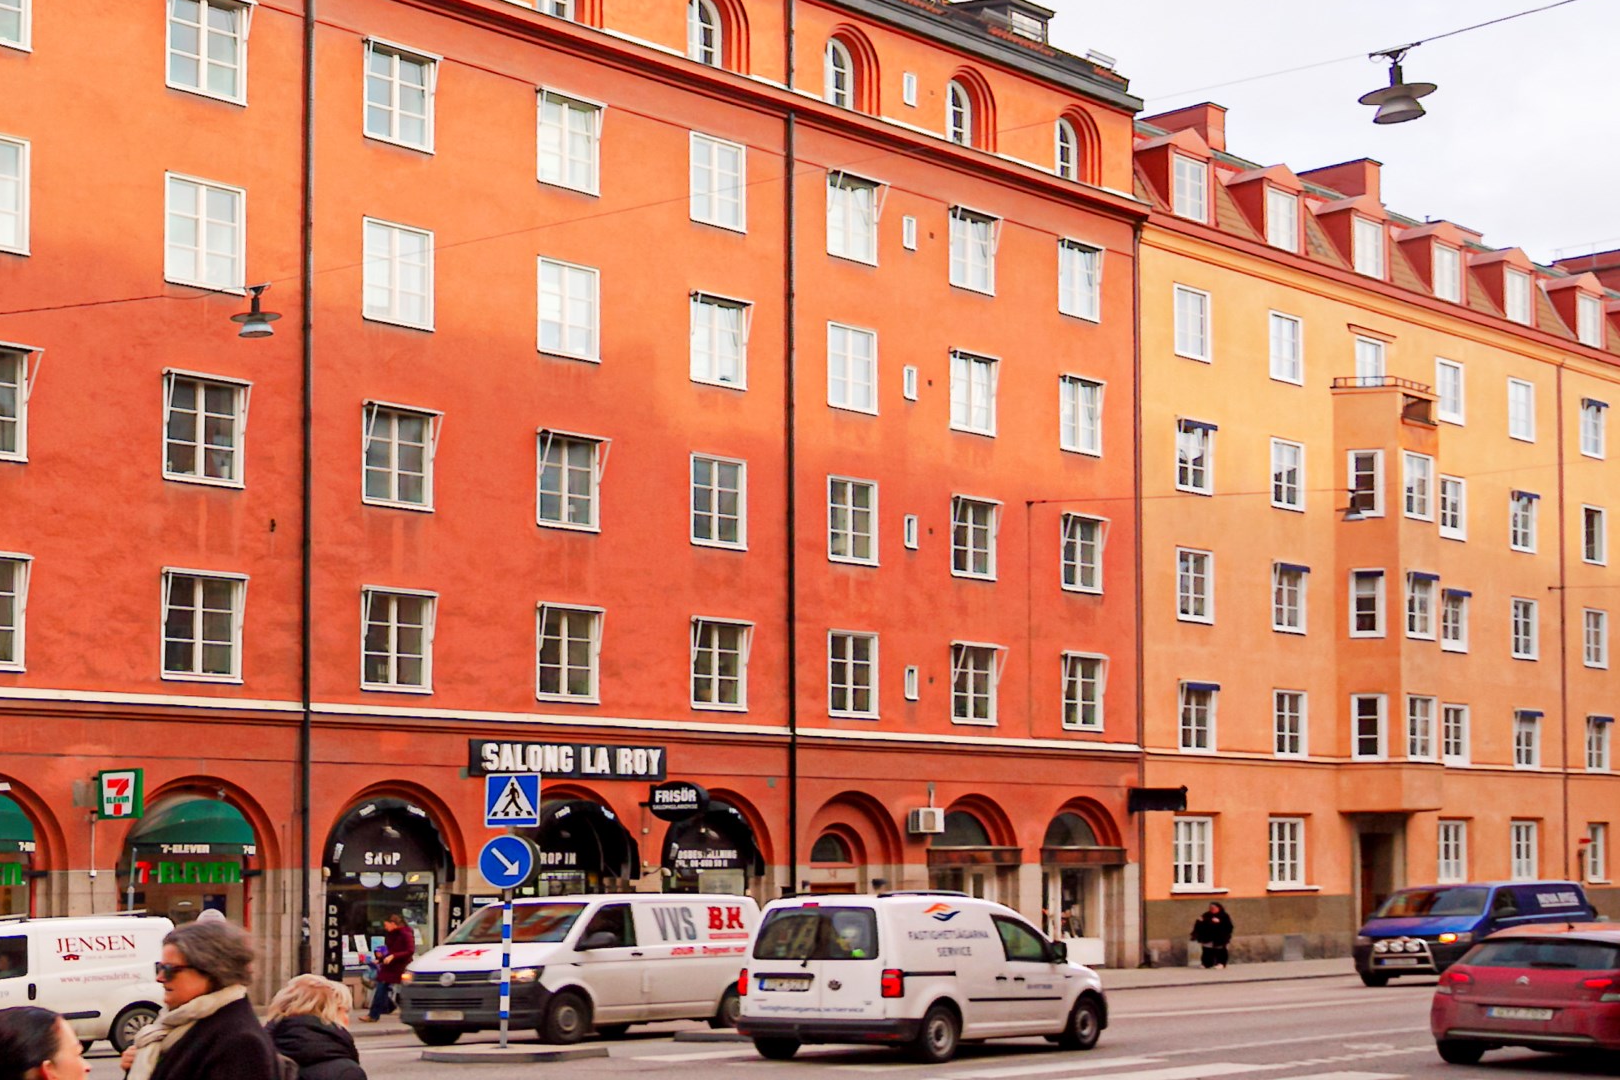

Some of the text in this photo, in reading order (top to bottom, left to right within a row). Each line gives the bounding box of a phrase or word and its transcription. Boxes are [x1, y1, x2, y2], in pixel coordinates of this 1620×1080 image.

[481, 742, 662, 776] SALONG LA ROY
[655, 787, 697, 803] FRISÖR
[540, 852, 577, 865] ROP IN
[651, 906, 697, 941] VVS
[56, 934, 136, 954] JENSEN
[936, 946, 972, 957] SERVICE
